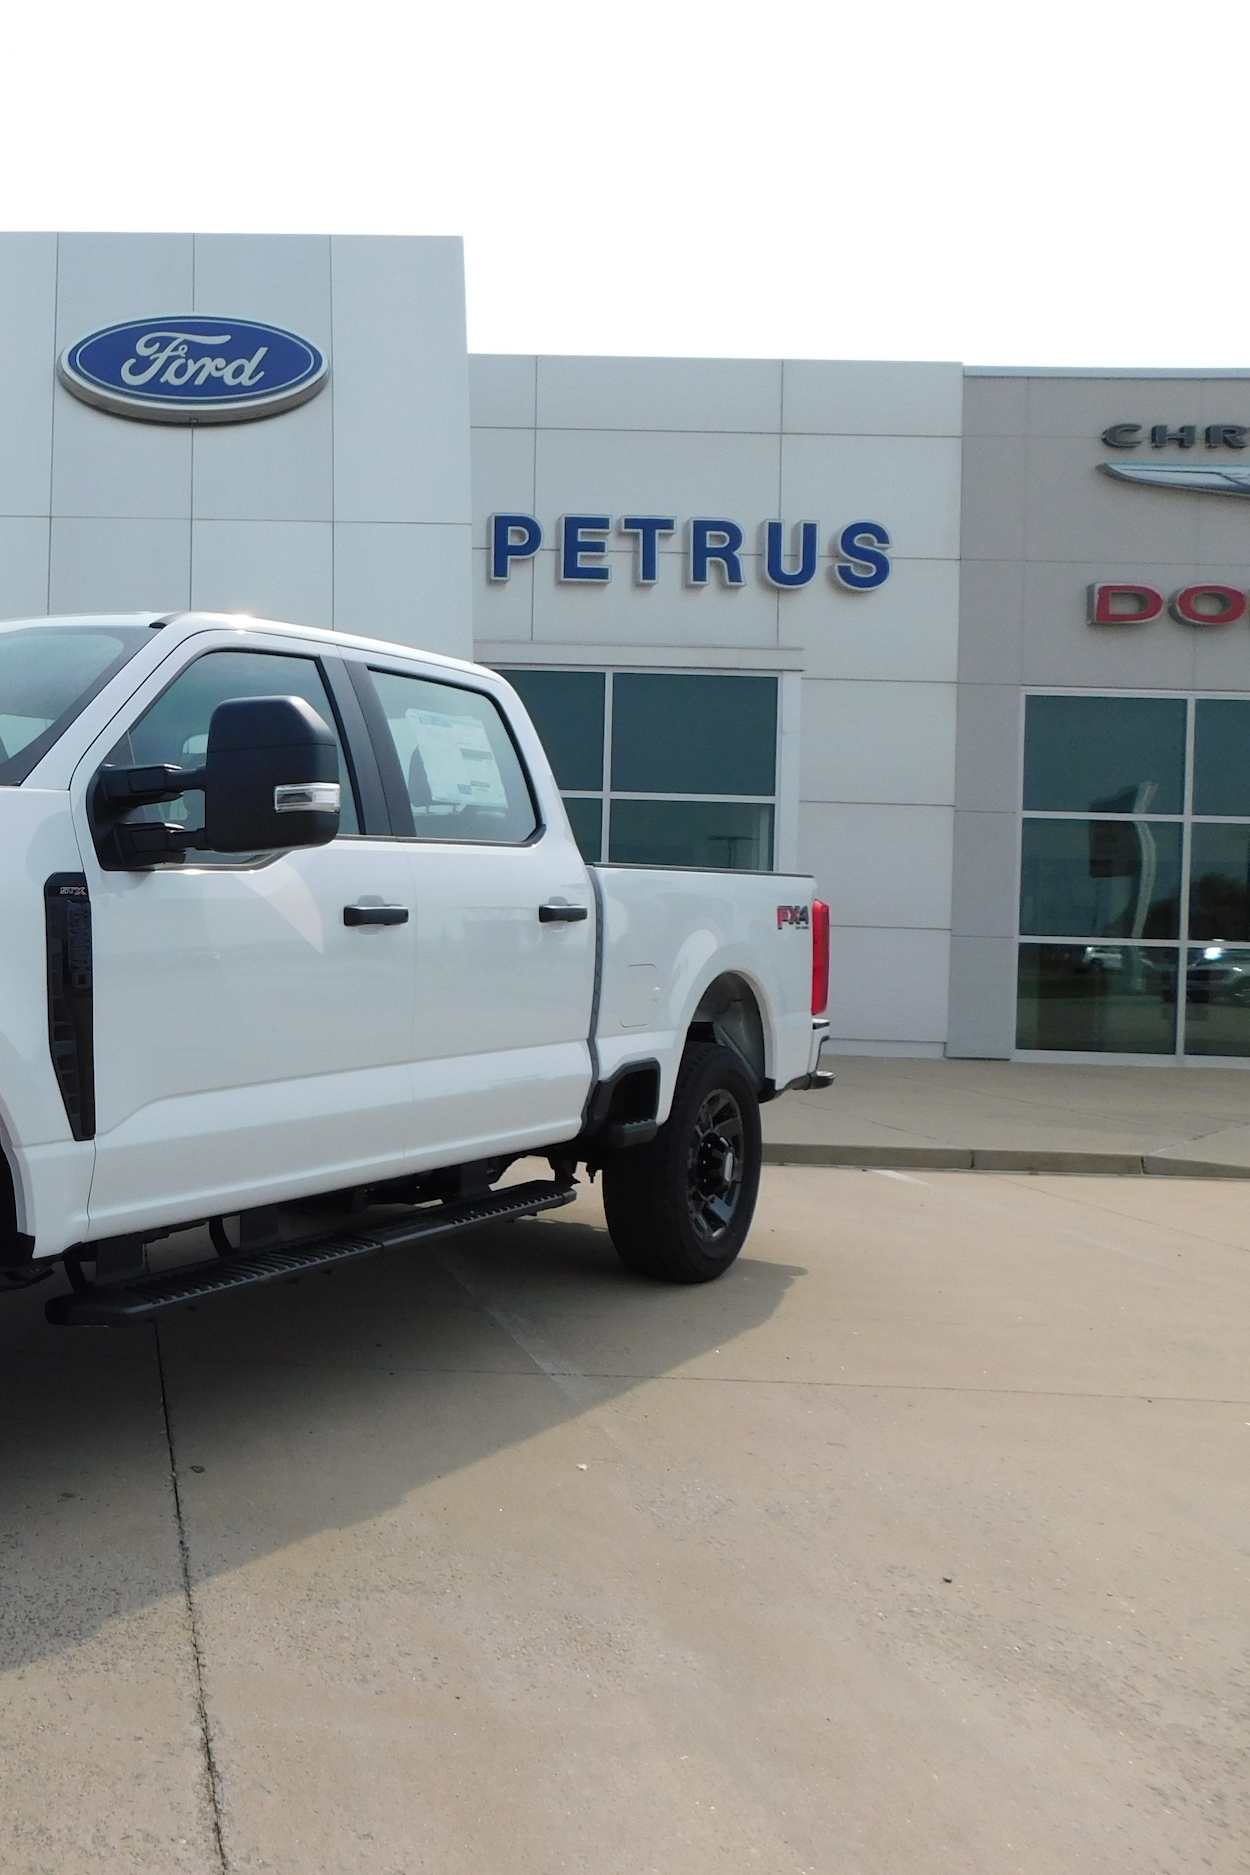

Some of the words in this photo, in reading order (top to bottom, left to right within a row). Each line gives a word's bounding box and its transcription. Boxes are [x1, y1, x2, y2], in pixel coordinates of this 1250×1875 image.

[120, 331, 269, 386] Ford
[1102, 423, 1250, 448] CHR
[487, 513, 893, 592] PETRUS
[1087, 581, 1248, 625] DO
[777, 906, 809, 930] FX4
